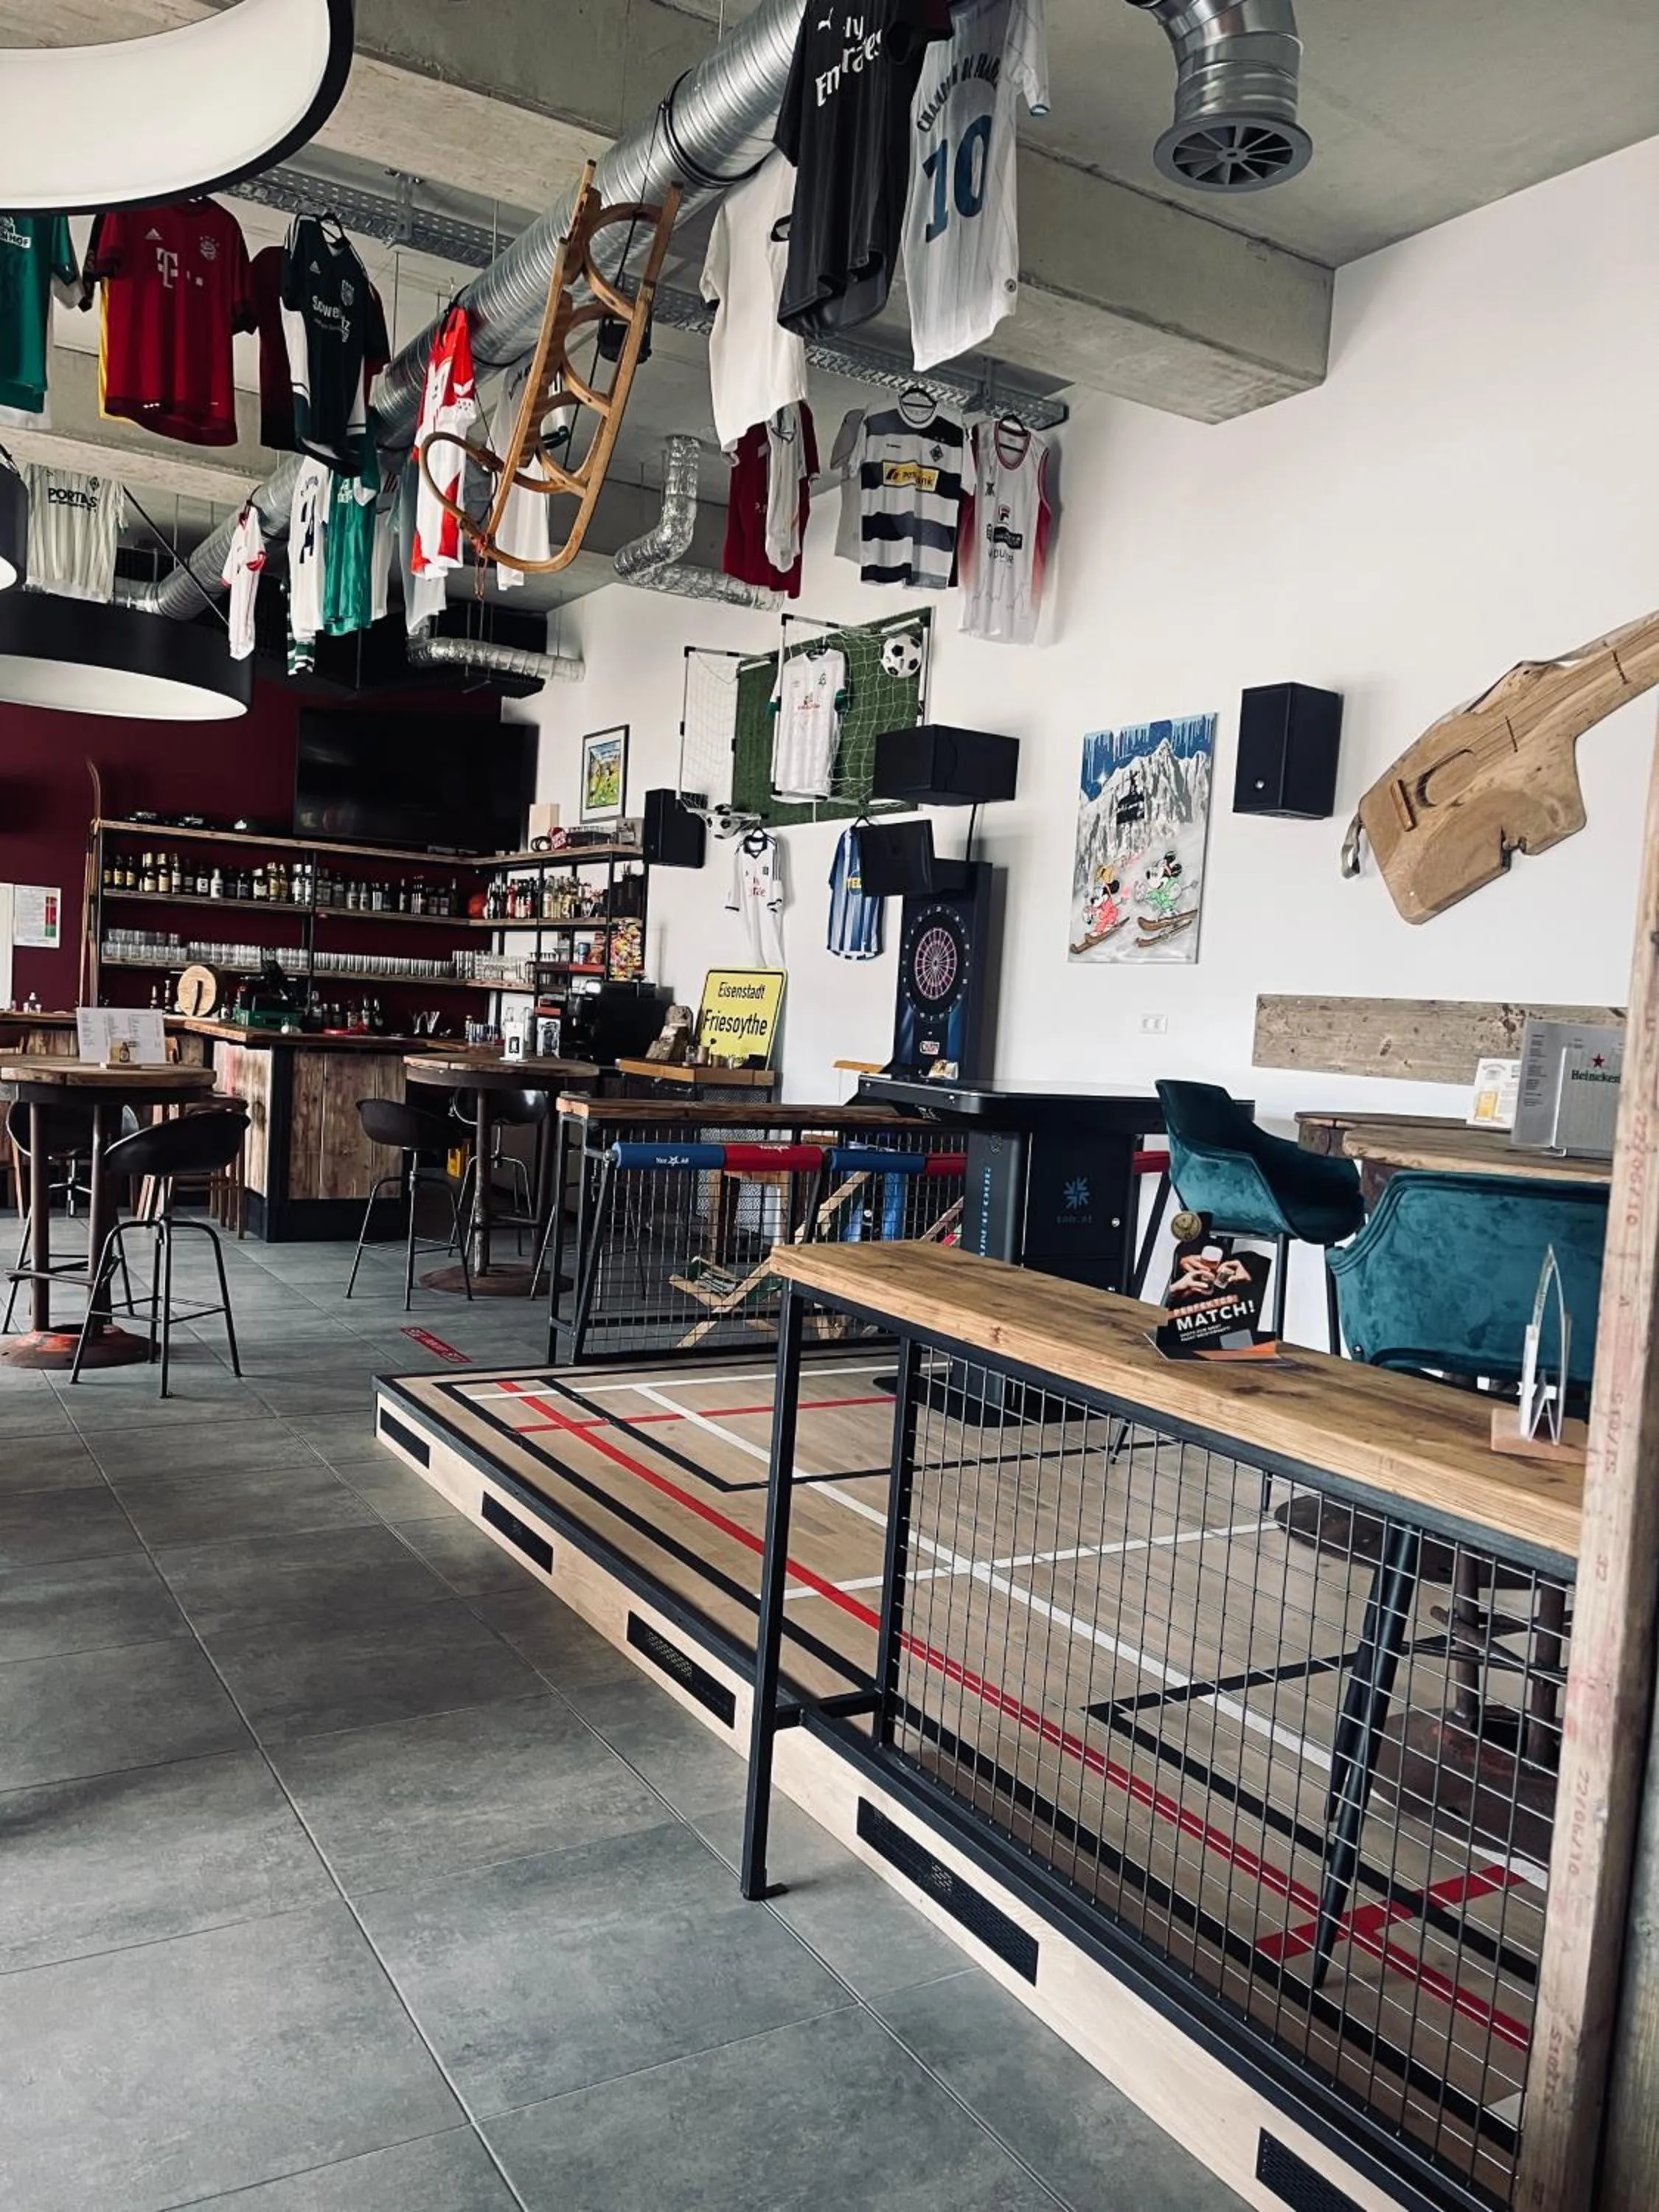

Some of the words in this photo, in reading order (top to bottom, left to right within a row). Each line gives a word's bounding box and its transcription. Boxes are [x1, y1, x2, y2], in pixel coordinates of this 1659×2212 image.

[922, 114, 992, 243] 10
[718, 981, 765, 999] Eisenstadt
[703, 1009, 768, 1040] Friesoythe
[1176, 1300, 1255, 1331] MATCH!
